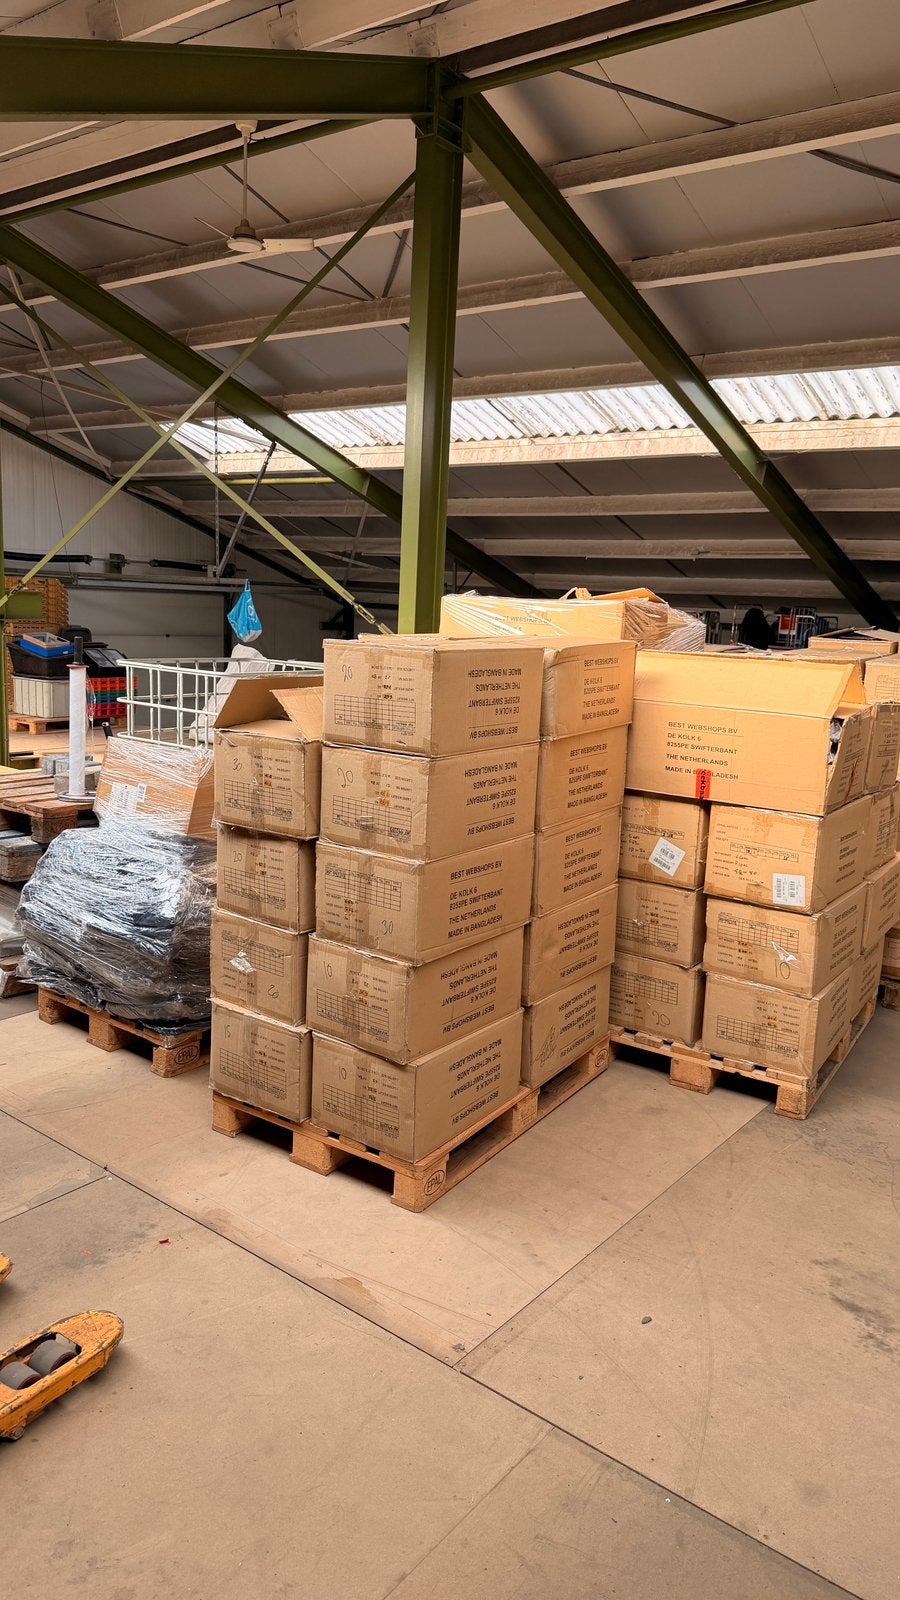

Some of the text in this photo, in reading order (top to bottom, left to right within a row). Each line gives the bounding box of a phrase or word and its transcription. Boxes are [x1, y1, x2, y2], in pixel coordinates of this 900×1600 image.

[468, 669, 501, 677] BANGLADESH
[476, 683, 510, 691] NETHERLANDS
[468, 698, 503, 707] SWIFTERBANT
[478, 728, 505, 738] WEBSHOPS
[506, 726, 518, 734] BEST
[688, 724, 726, 733] WEBSHOPS
[691, 744, 737, 754] SWIFTERBANT
[505, 761, 517, 770] MADE
[680, 756, 728, 766] NETHERLANDS
[465, 765, 498, 777] BANGLADESH
[693, 769, 738, 779] BLADESH
[473, 777, 507, 789] NETHERLANDS
[467, 792, 500, 805] SWIFTERBANT
[497, 800, 509, 809] KOLK
[476, 821, 502, 833] WEBSHOPS
[503, 817, 514, 826] BEST
[451, 870, 464, 880] BEST
[466, 862, 494, 876] WEBSHOPS
[450, 892, 457, 900] DE
[459, 888, 473, 897] KOLK
[470, 888, 503, 904] SWIFTERBANT
[450, 904, 496, 924] THE NETHERLANDS
[382, 920, 393, 935] 30
[448, 928, 463, 938] MADE
[470, 914, 502, 931] BANGLADESH
[775, 959, 790, 979] 10
[652, 1010, 670, 1027] 20
[178, 1048, 196, 1062] EPAL
[339, 1067, 347, 1080] 10
